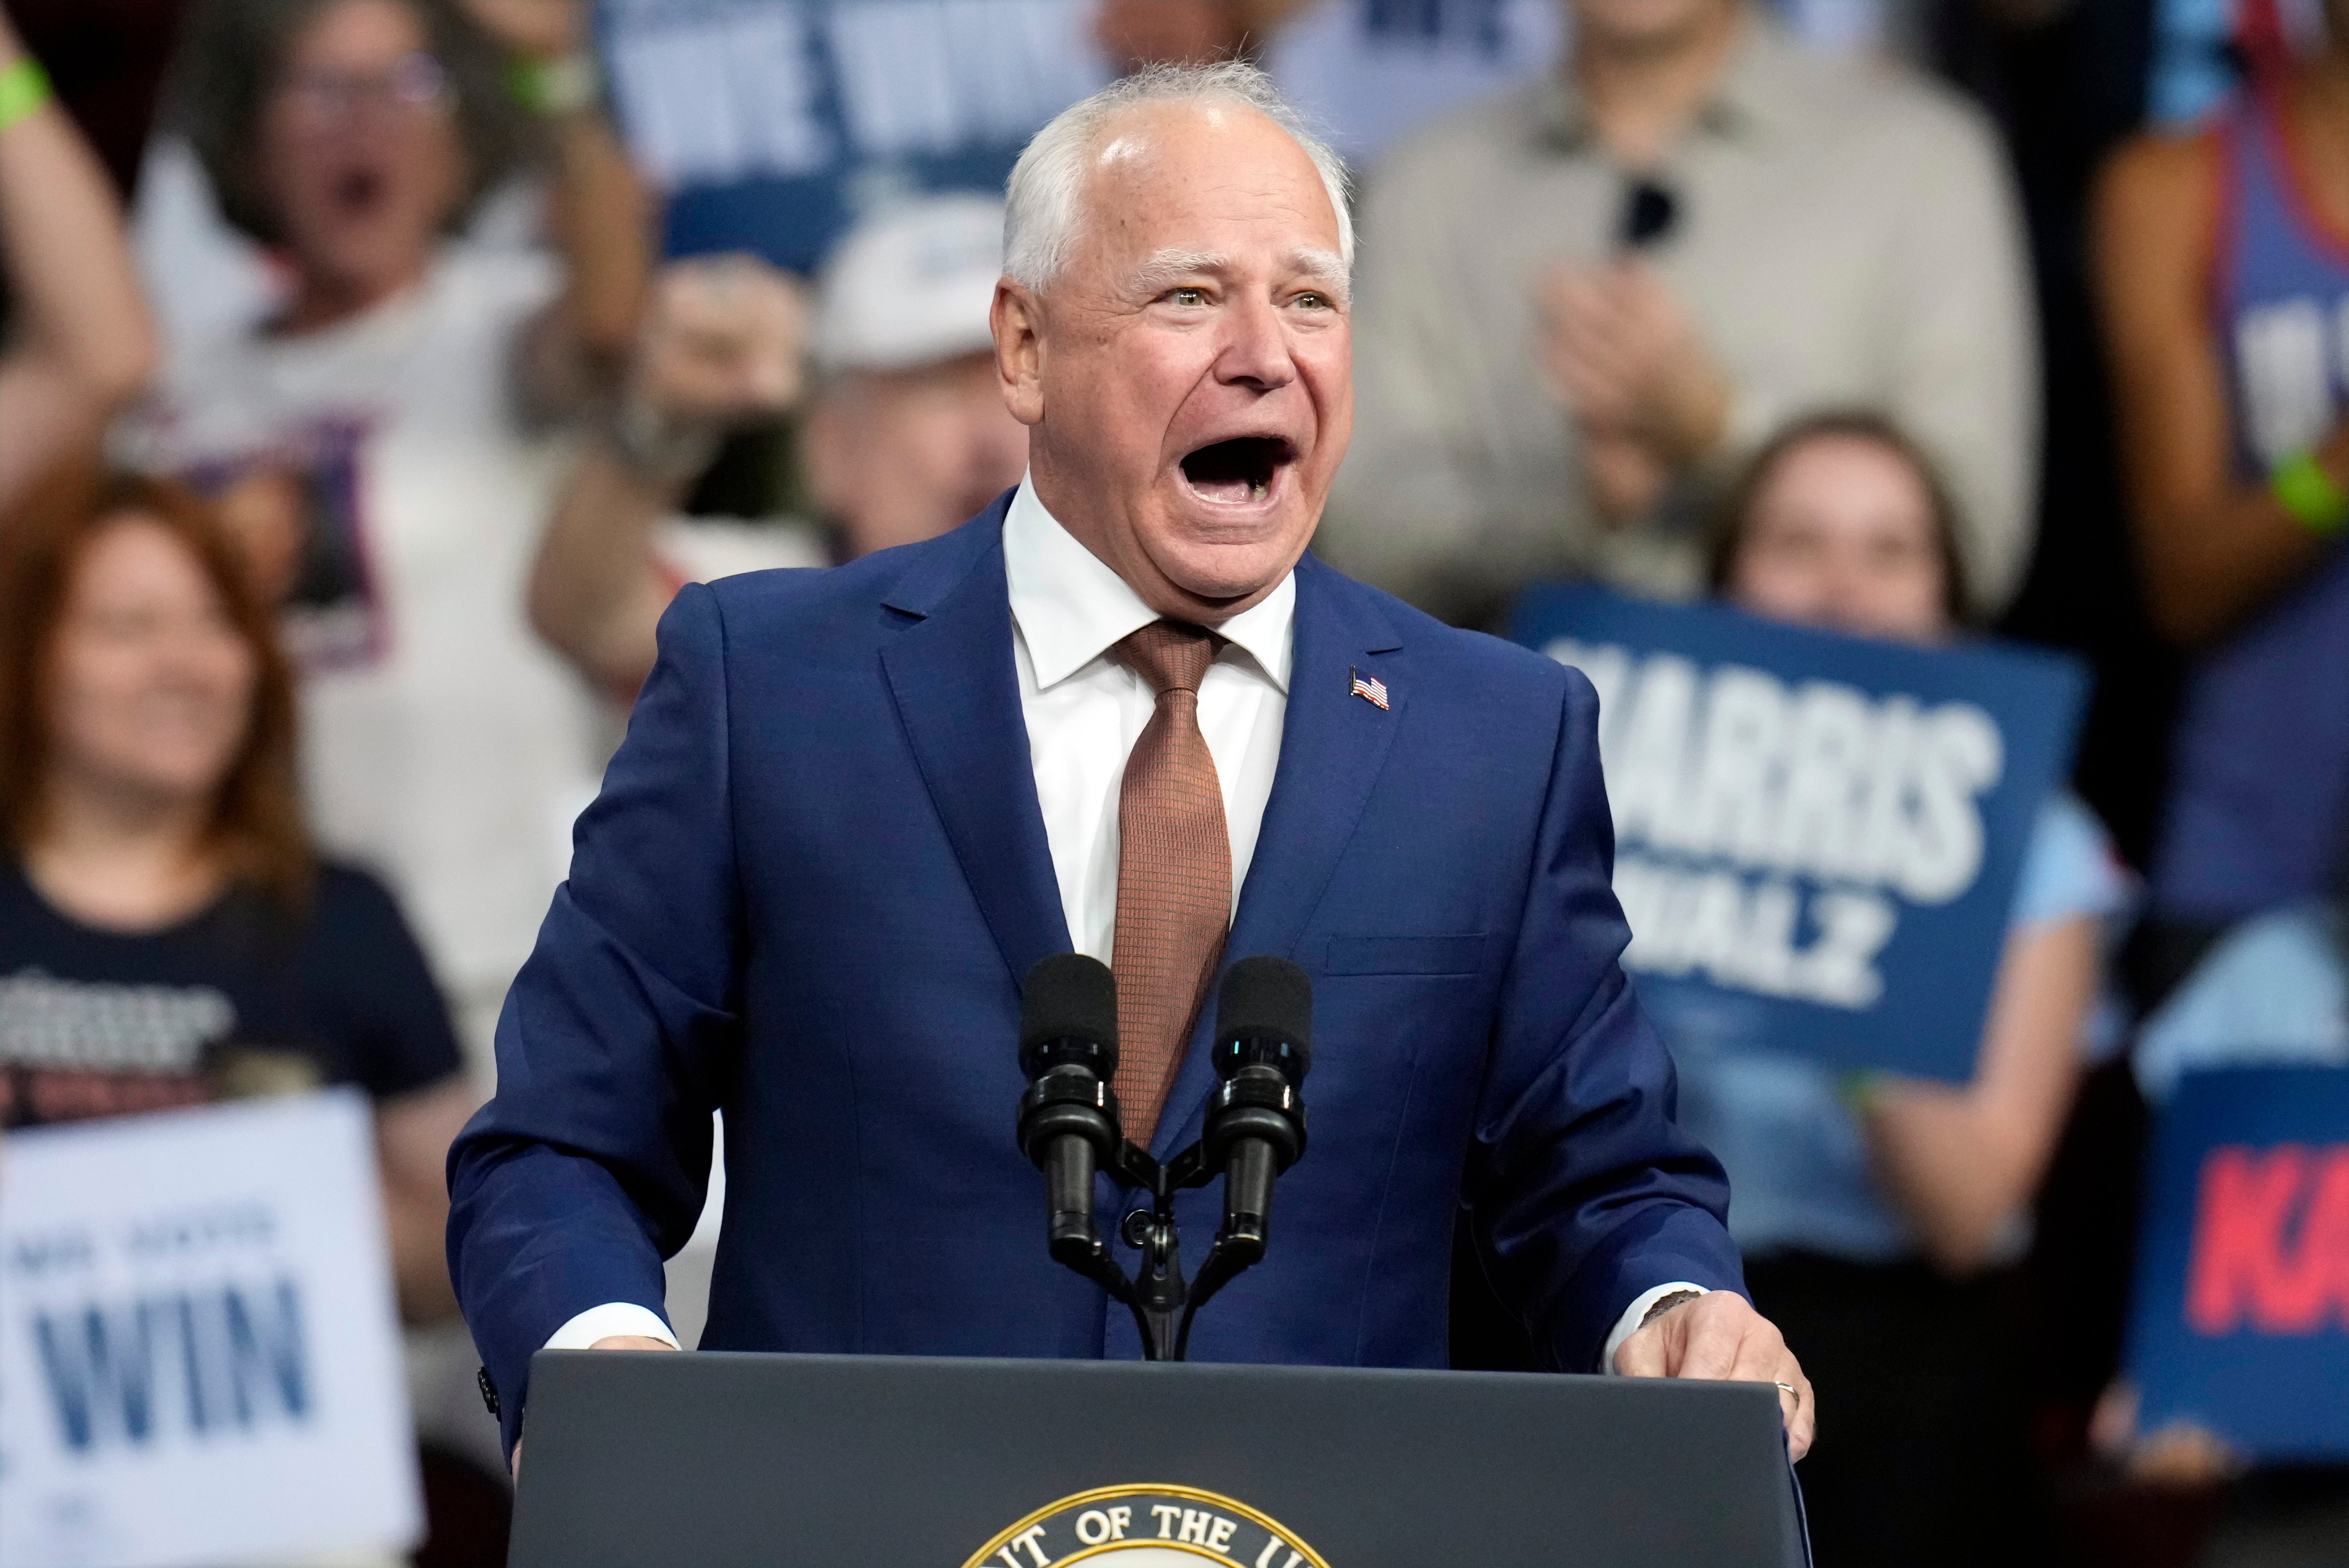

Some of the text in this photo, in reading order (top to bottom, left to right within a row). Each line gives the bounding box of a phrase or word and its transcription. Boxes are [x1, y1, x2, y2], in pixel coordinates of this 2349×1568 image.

[34, 1277, 312, 1455] WIN
[1075, 1506, 1132, 1545] OF
[1150, 1504, 1238, 1554] THE
[1255, 1535, 1316, 1568] U
